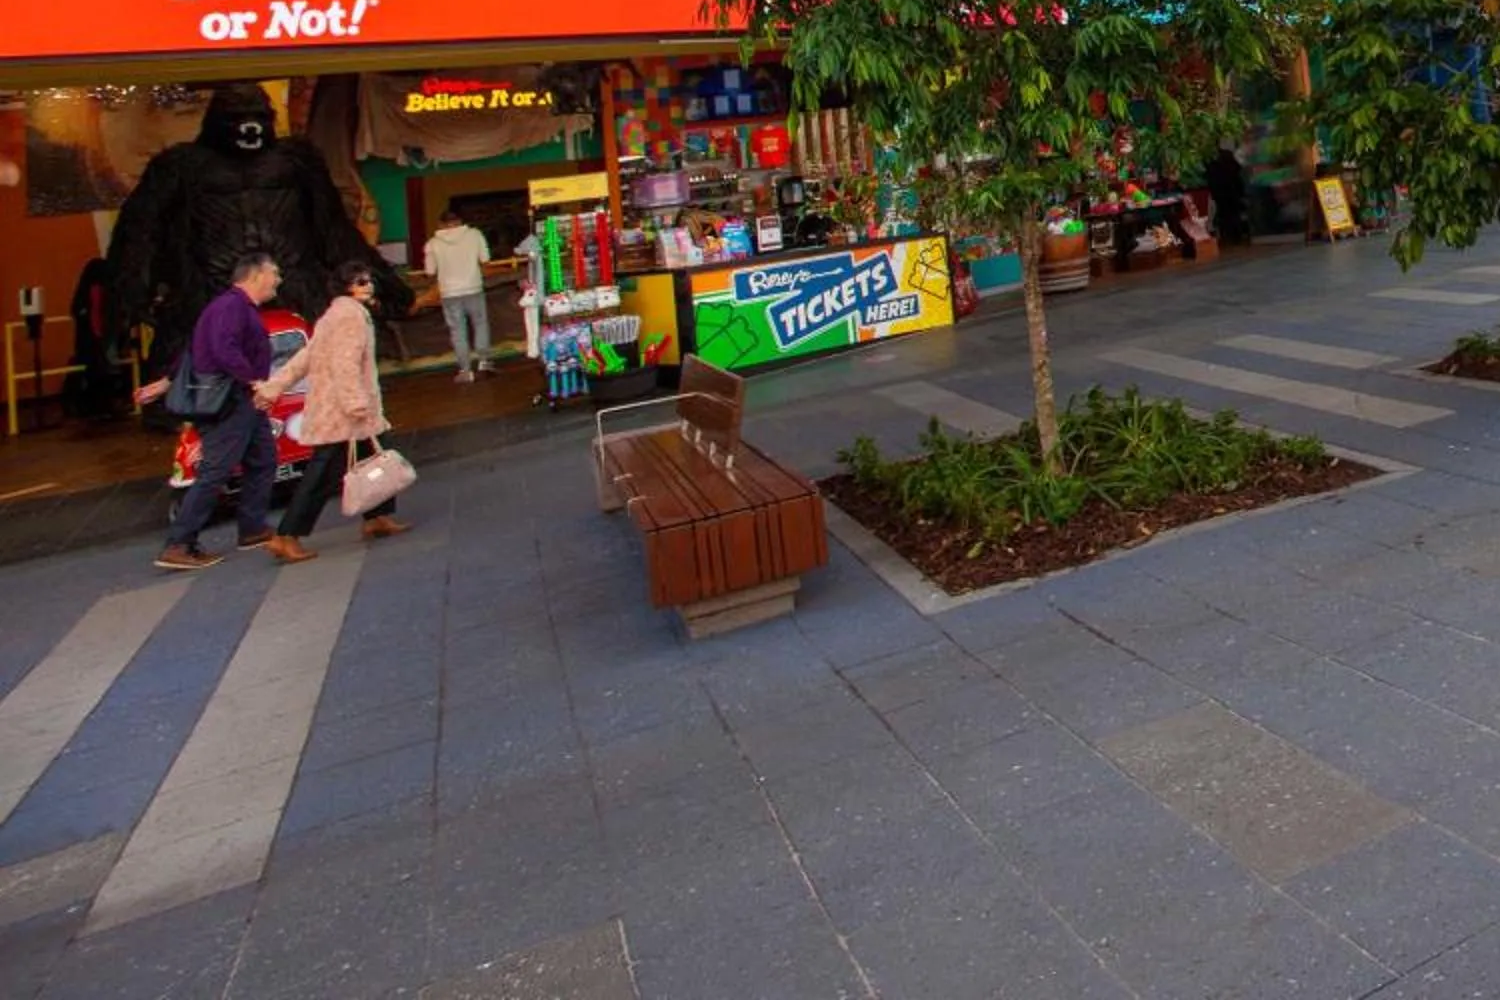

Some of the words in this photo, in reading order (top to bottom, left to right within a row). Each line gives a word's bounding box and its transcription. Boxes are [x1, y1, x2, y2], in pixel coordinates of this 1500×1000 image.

[200, 11, 257, 40] or
[405, 92, 485, 113] Believe
[489, 88, 509, 109] It
[512, 90, 537, 106] or
[780, 262, 887, 337] TICKETS
[866, 297, 915, 323] HERE!
